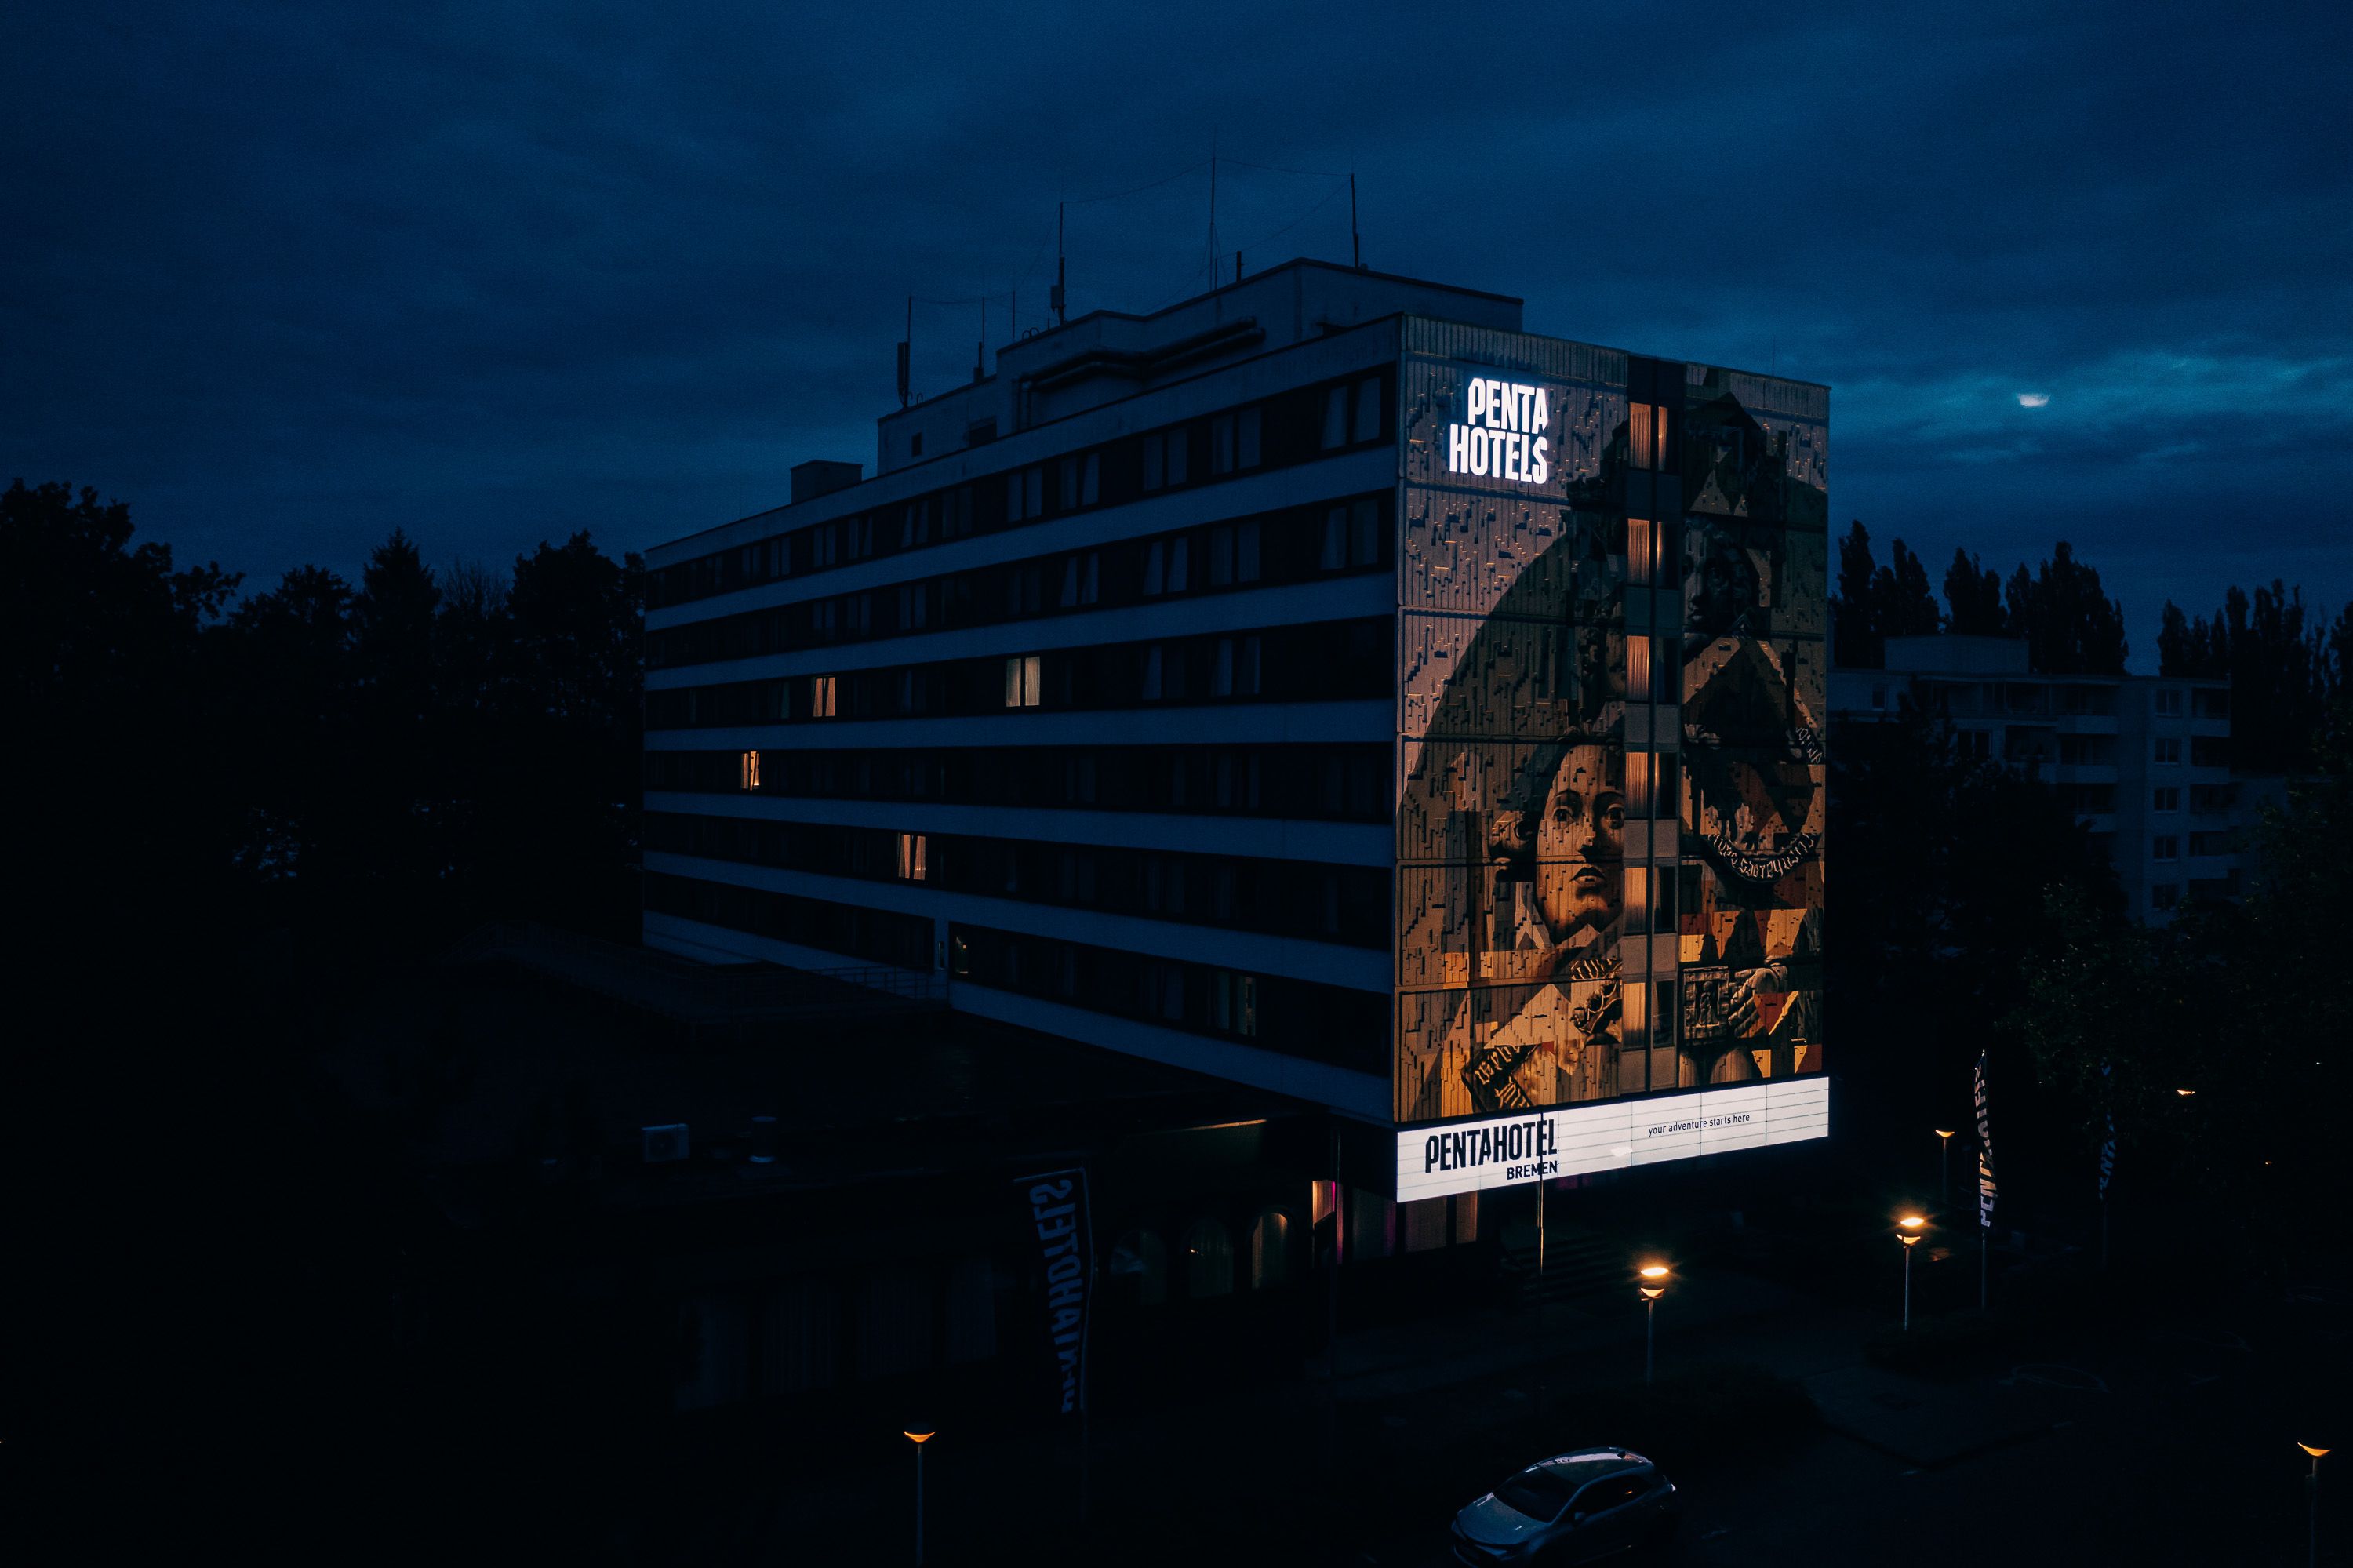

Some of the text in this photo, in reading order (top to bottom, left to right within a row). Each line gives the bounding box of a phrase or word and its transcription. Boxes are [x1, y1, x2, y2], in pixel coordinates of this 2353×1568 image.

[1467, 377, 1548, 435] PENTA
[1449, 424, 1548, 485] HOTELS
[1425, 1119, 1558, 1173] PENTAHOTEL
[1648, 1114, 1751, 1138] your adventure starts here
[1507, 1160, 1558, 1181] BREMEN
